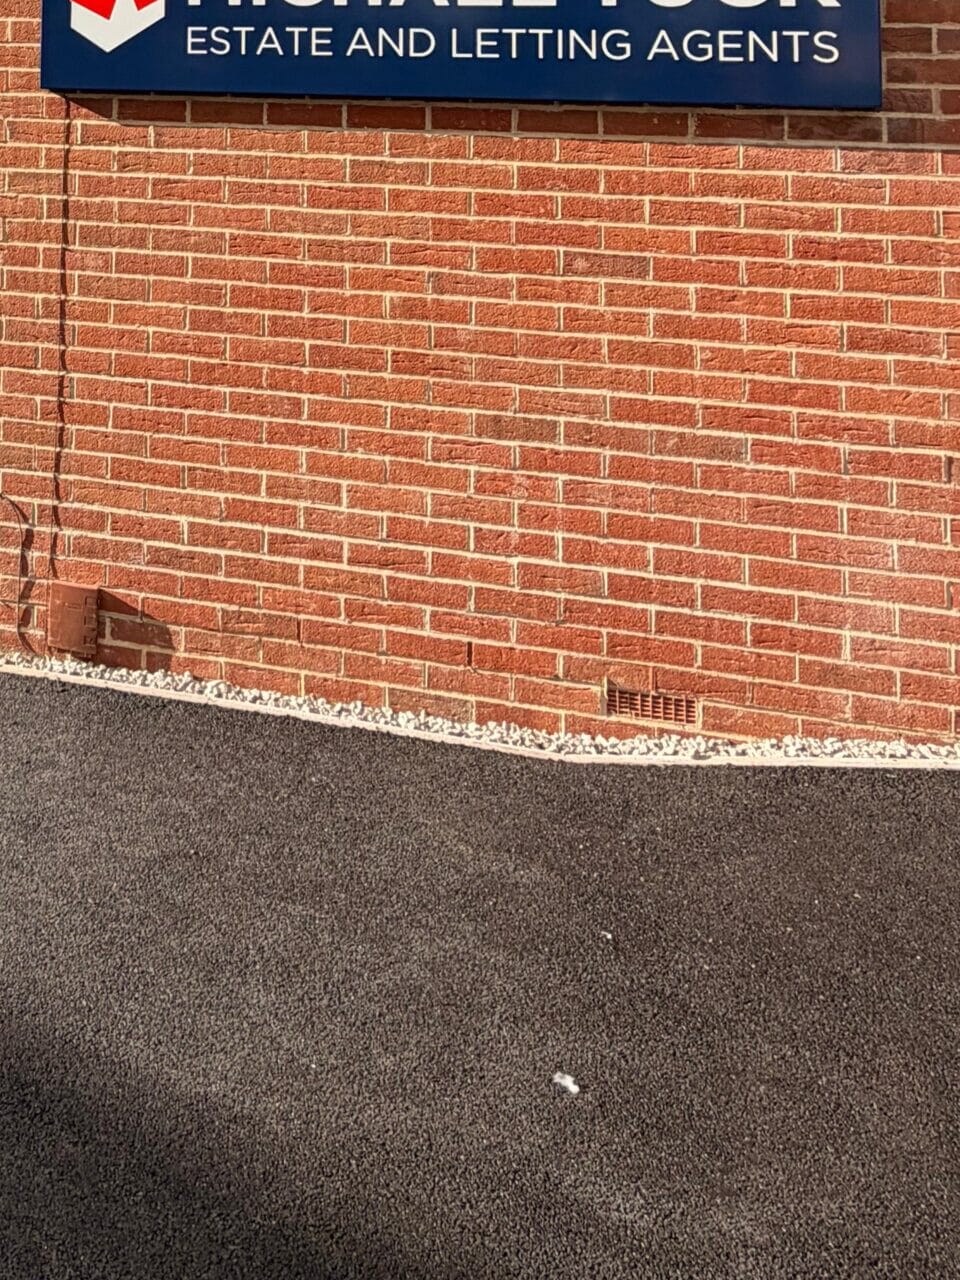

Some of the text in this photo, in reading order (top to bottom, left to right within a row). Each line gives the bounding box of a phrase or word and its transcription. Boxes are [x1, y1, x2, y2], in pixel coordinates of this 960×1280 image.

[186, 26, 840, 64] ESTATE AND LETTING AGENTS
